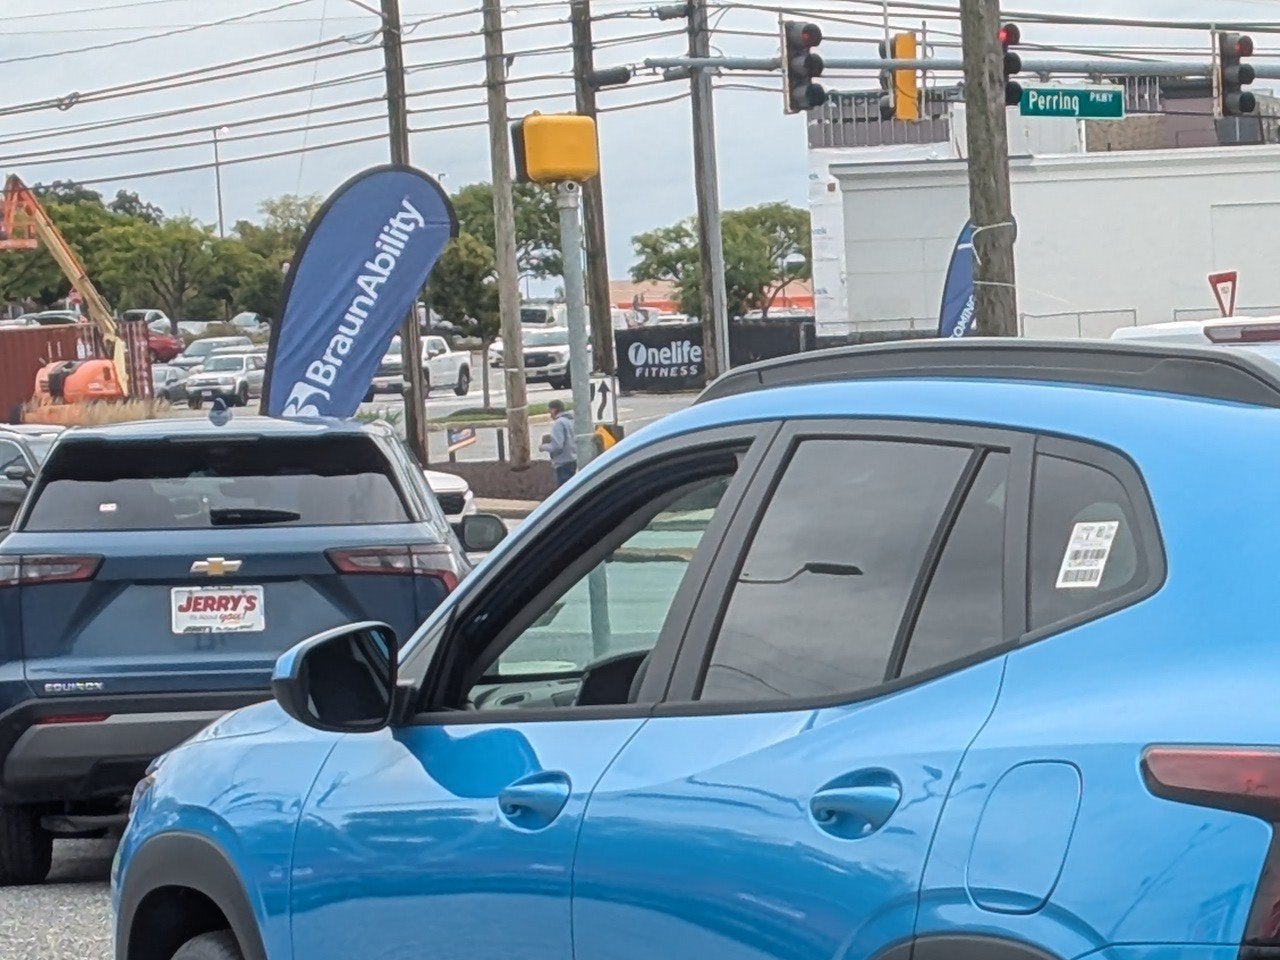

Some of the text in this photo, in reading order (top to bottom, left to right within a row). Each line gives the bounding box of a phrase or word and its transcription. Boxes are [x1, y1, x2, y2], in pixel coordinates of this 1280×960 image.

[1029, 90, 1080, 115] Perring
[305, 198, 425, 387] BraunAbility
[628, 340, 703, 366] Onelife
[635, 365, 698, 378] FITNESS
[178, 594, 257, 612] JERRY'S
[44, 682, 104, 692] EQUINOX
